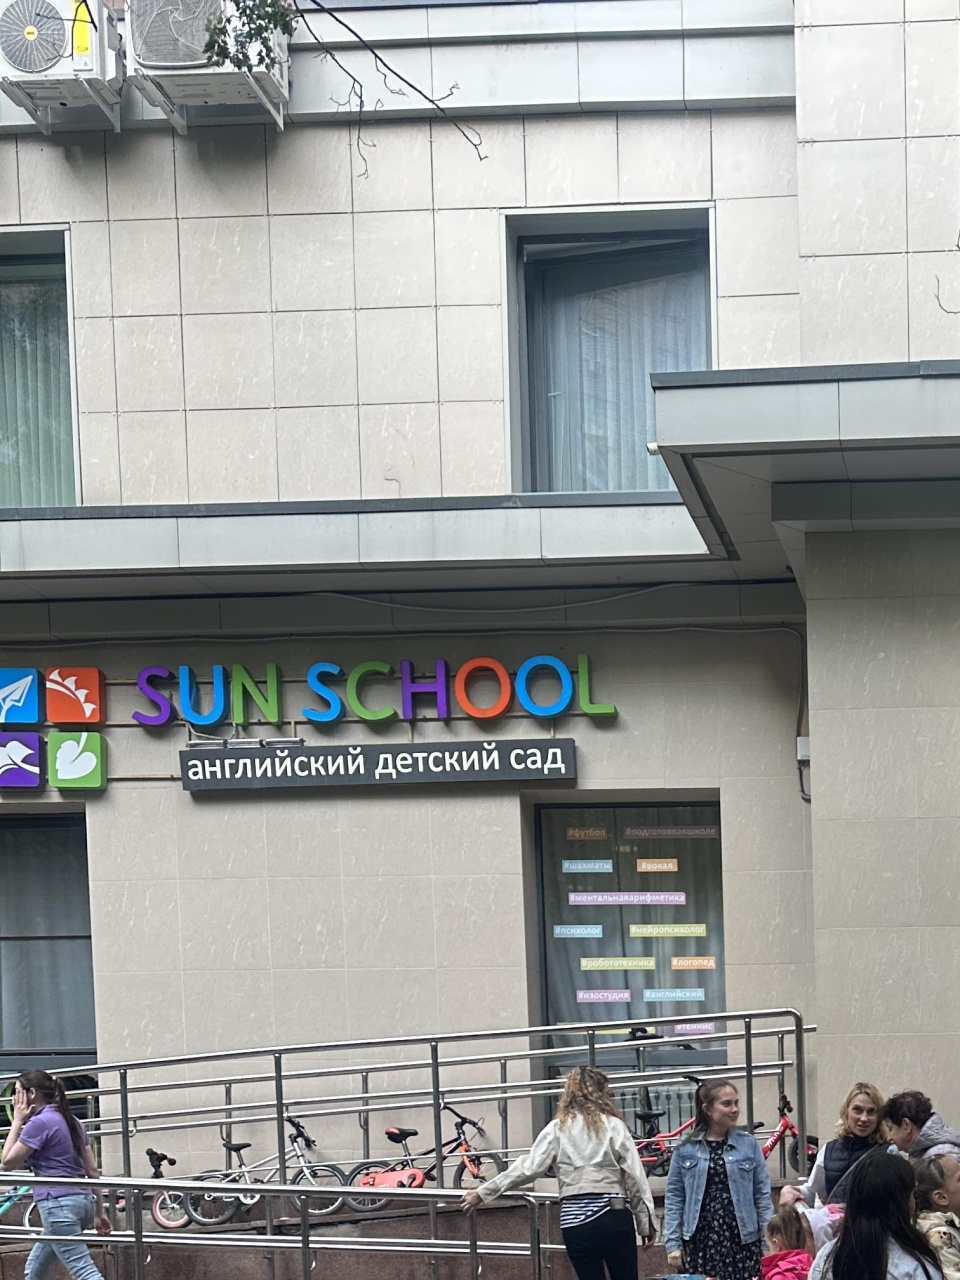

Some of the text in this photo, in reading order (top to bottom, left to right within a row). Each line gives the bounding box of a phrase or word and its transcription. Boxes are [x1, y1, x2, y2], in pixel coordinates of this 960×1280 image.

[131, 652, 619, 727] SUN SCHOOL
[186, 742, 566, 781] английский детский сад
[568, 827, 606, 838] #футбол
[564, 860, 612, 870] #шахматы
[641, 860, 673, 870] #вокал
[570, 892, 686, 905] #ментальнаяарифметика
[555, 925, 602, 936] #психолог
[630, 924, 705, 936] #нейропсихолог
[581, 957, 654, 968] #робототехника
[672, 957, 715, 969] #логопед
[578, 990, 629, 1001] #изостудия
[645, 988, 703, 999] #английский
